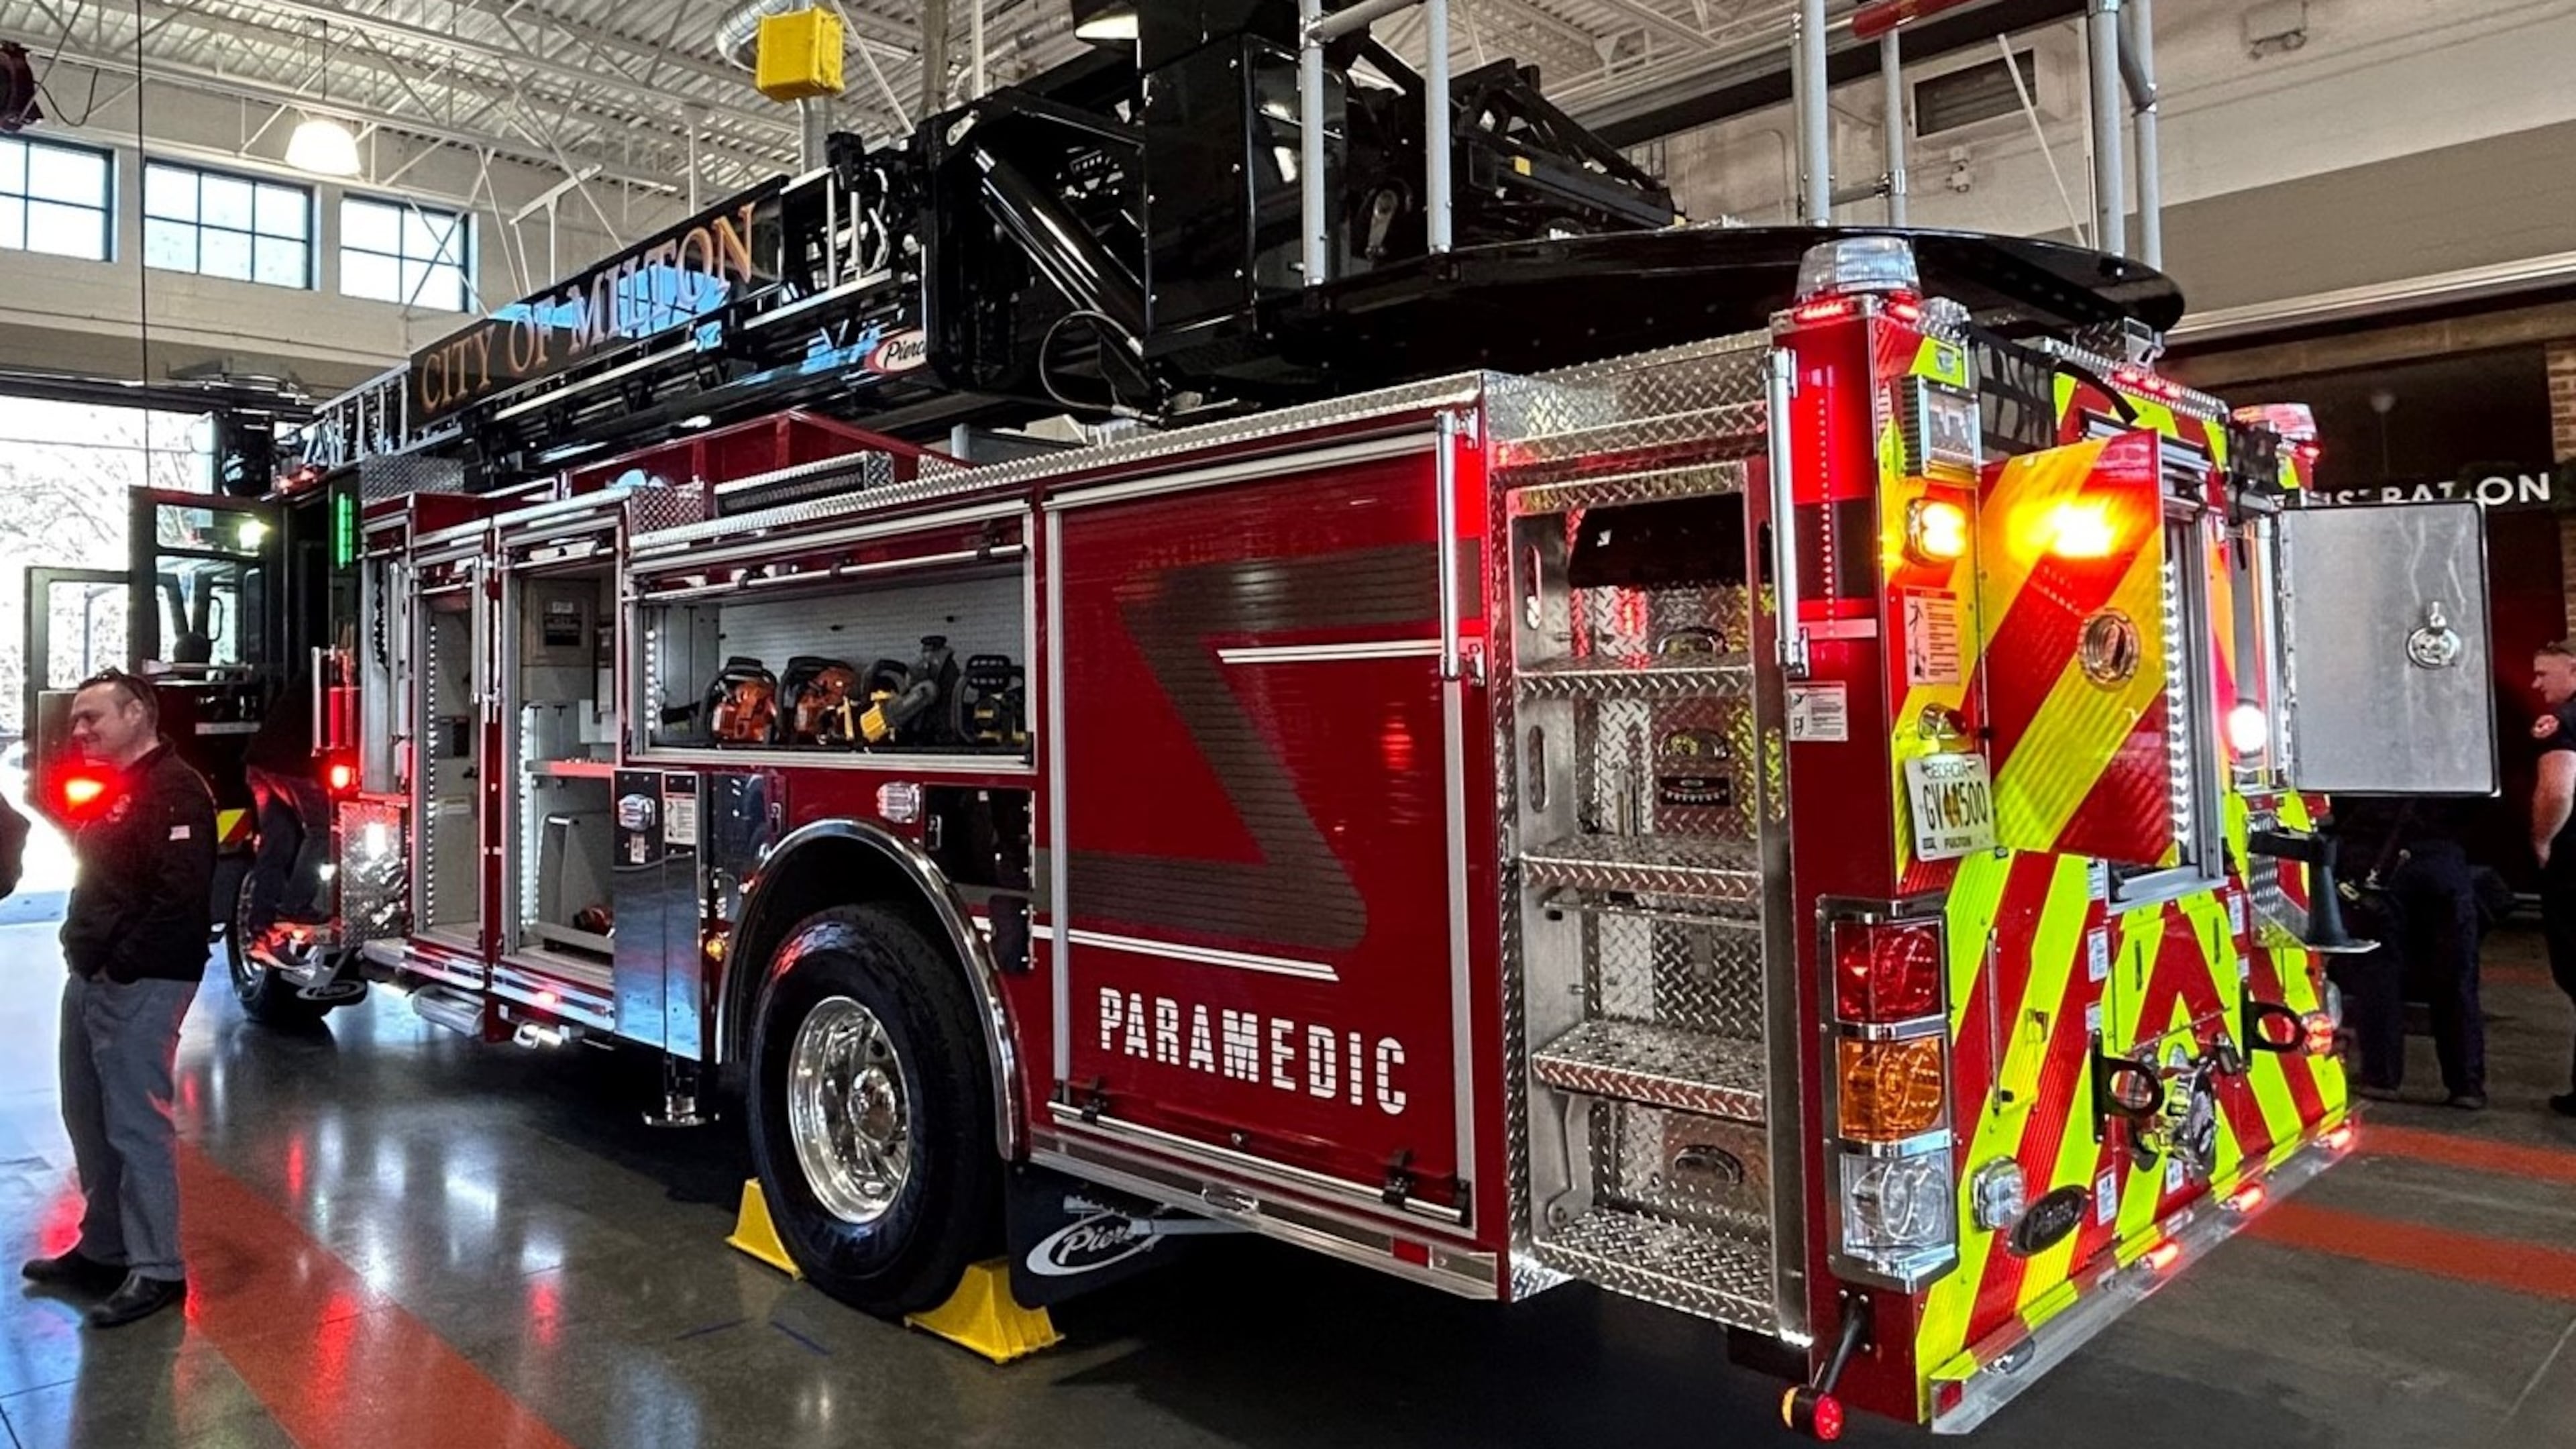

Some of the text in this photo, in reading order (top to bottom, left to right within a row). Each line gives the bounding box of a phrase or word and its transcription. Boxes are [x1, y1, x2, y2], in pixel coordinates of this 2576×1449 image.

[421, 202, 755, 413] CITY OF MILTON
[884, 340, 926, 368] Pierc
[1099, 987, 1406, 1115] PARAMEDIC
[1056, 1224, 1136, 1265] Pier
